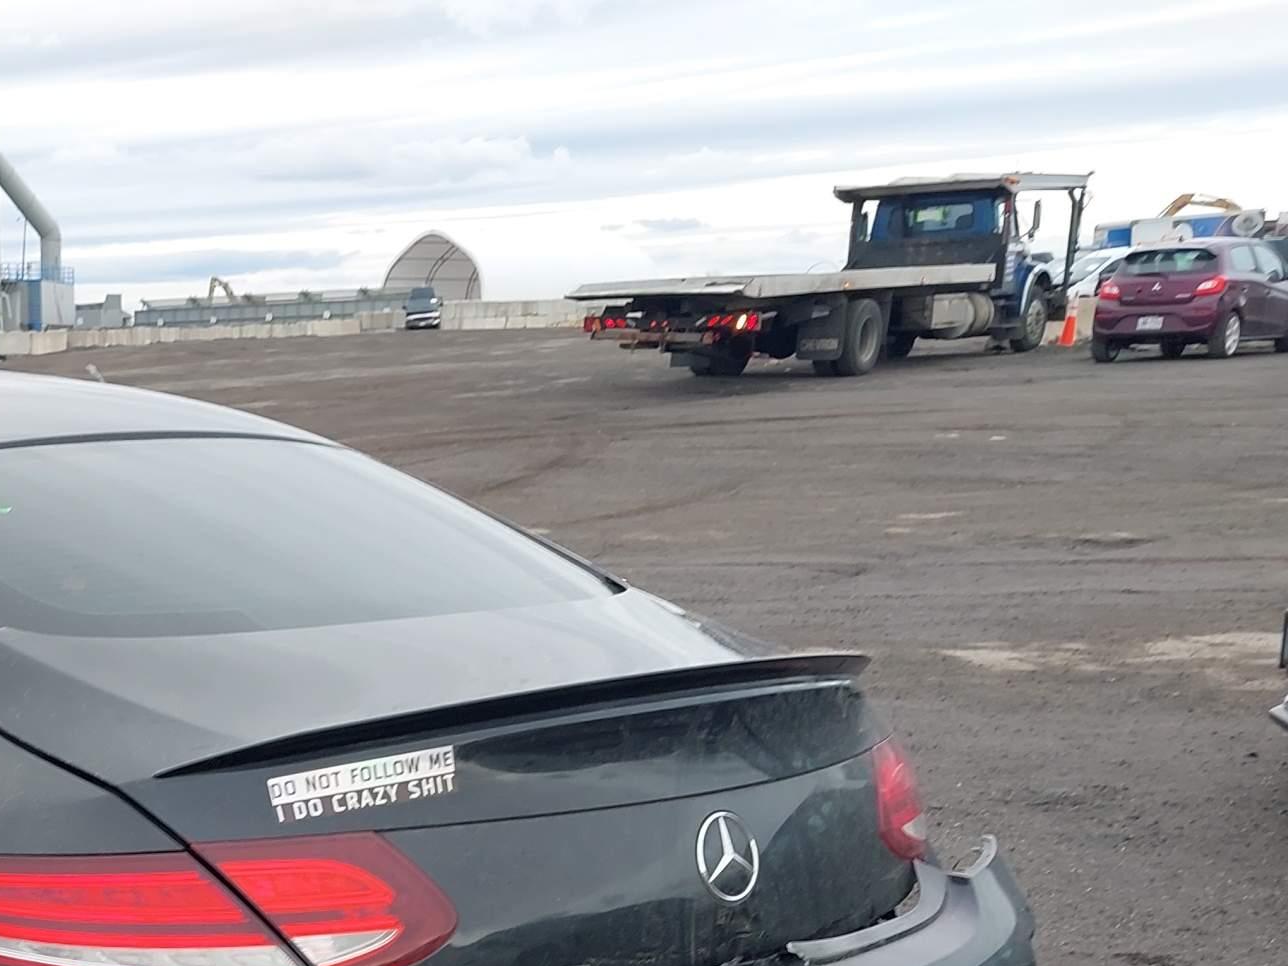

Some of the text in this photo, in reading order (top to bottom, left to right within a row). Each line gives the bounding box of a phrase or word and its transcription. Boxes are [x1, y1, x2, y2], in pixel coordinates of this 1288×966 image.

[270, 751, 454, 799] DO NOT FOLLOW ME
[275, 773, 456, 823] I DO CRAZY SHIT
